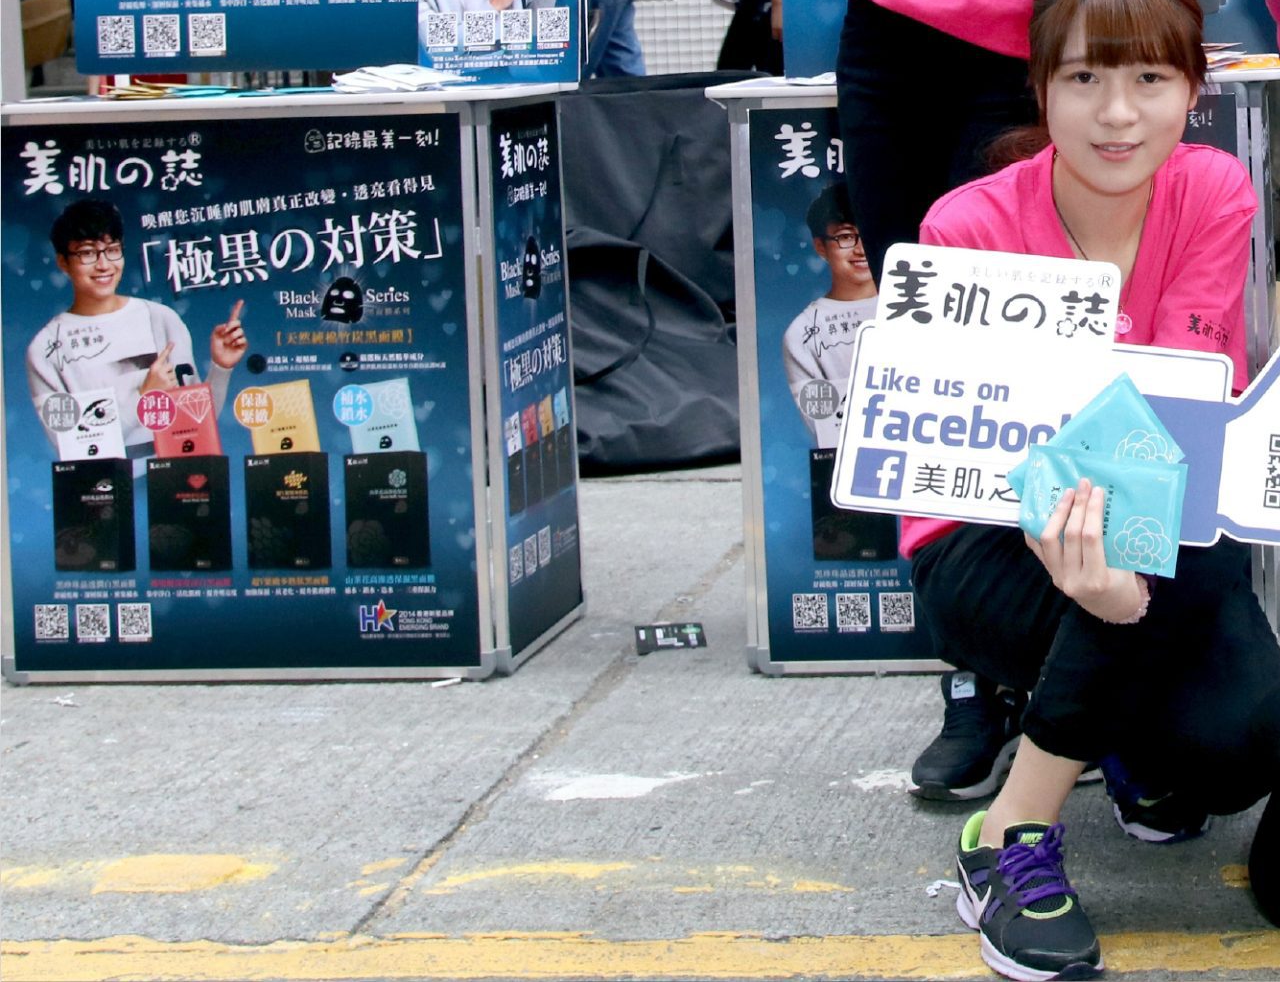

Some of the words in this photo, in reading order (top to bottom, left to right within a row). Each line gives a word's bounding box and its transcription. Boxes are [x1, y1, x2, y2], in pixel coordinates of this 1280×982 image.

[1188, 109, 1213, 130] 刻!
[19, 140, 204, 196] 美肌の誌
[279, 290, 320, 306] Black
[365, 286, 410, 303] Series
[286, 307, 317, 318] Mask
[886, 260, 1113, 338] 美肌の誌
[864, 365, 921, 396] Like
[933, 376, 966, 400] us
[978, 381, 1010, 403] on
[862, 394, 1072, 453] faceboo
